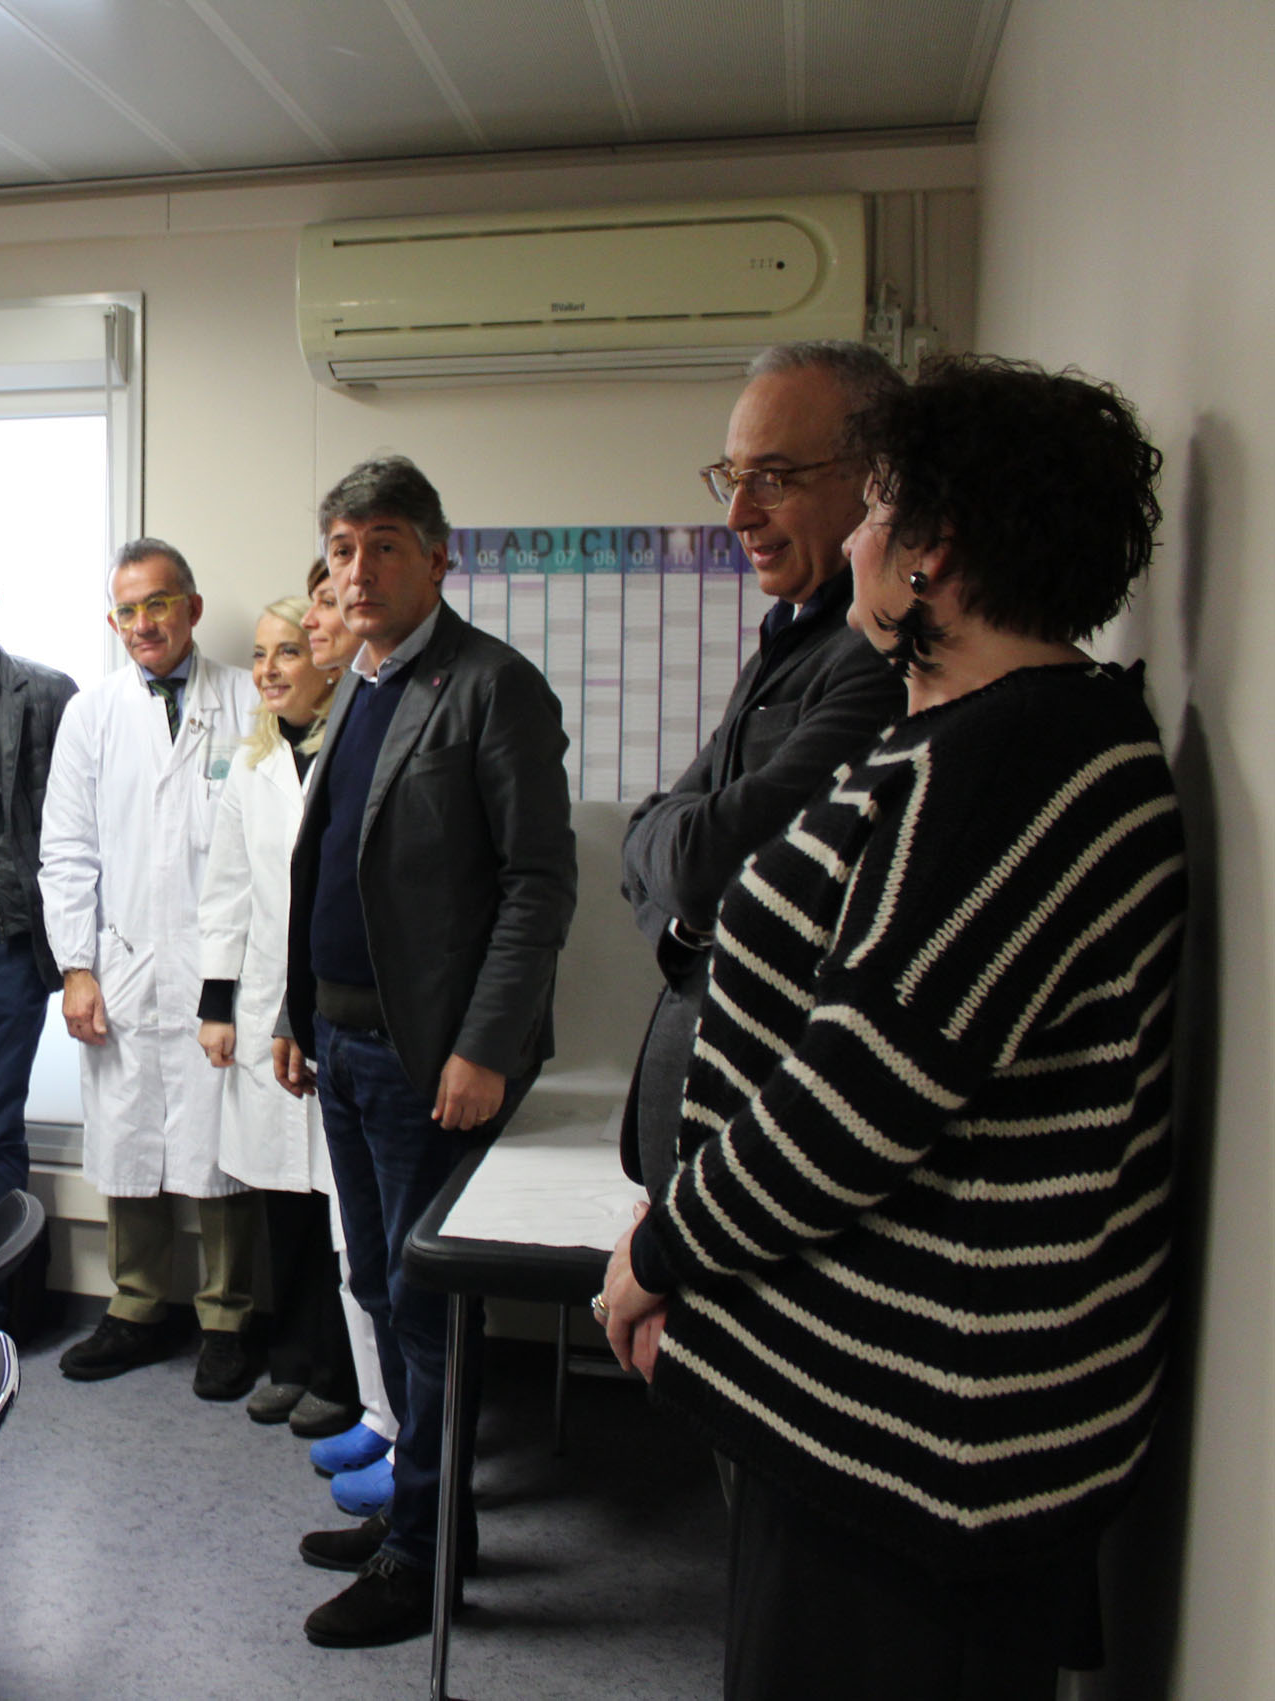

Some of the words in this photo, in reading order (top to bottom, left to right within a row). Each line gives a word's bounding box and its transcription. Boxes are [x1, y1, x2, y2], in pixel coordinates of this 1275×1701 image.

[477, 549, 500, 567] 05
[517, 549, 540, 567] 06
[556, 549, 577, 566] 07
[593, 549, 617, 566] 08
[632, 549, 655, 566] 09
[673, 549, 695, 565] 10
[714, 549, 731, 565] 11
